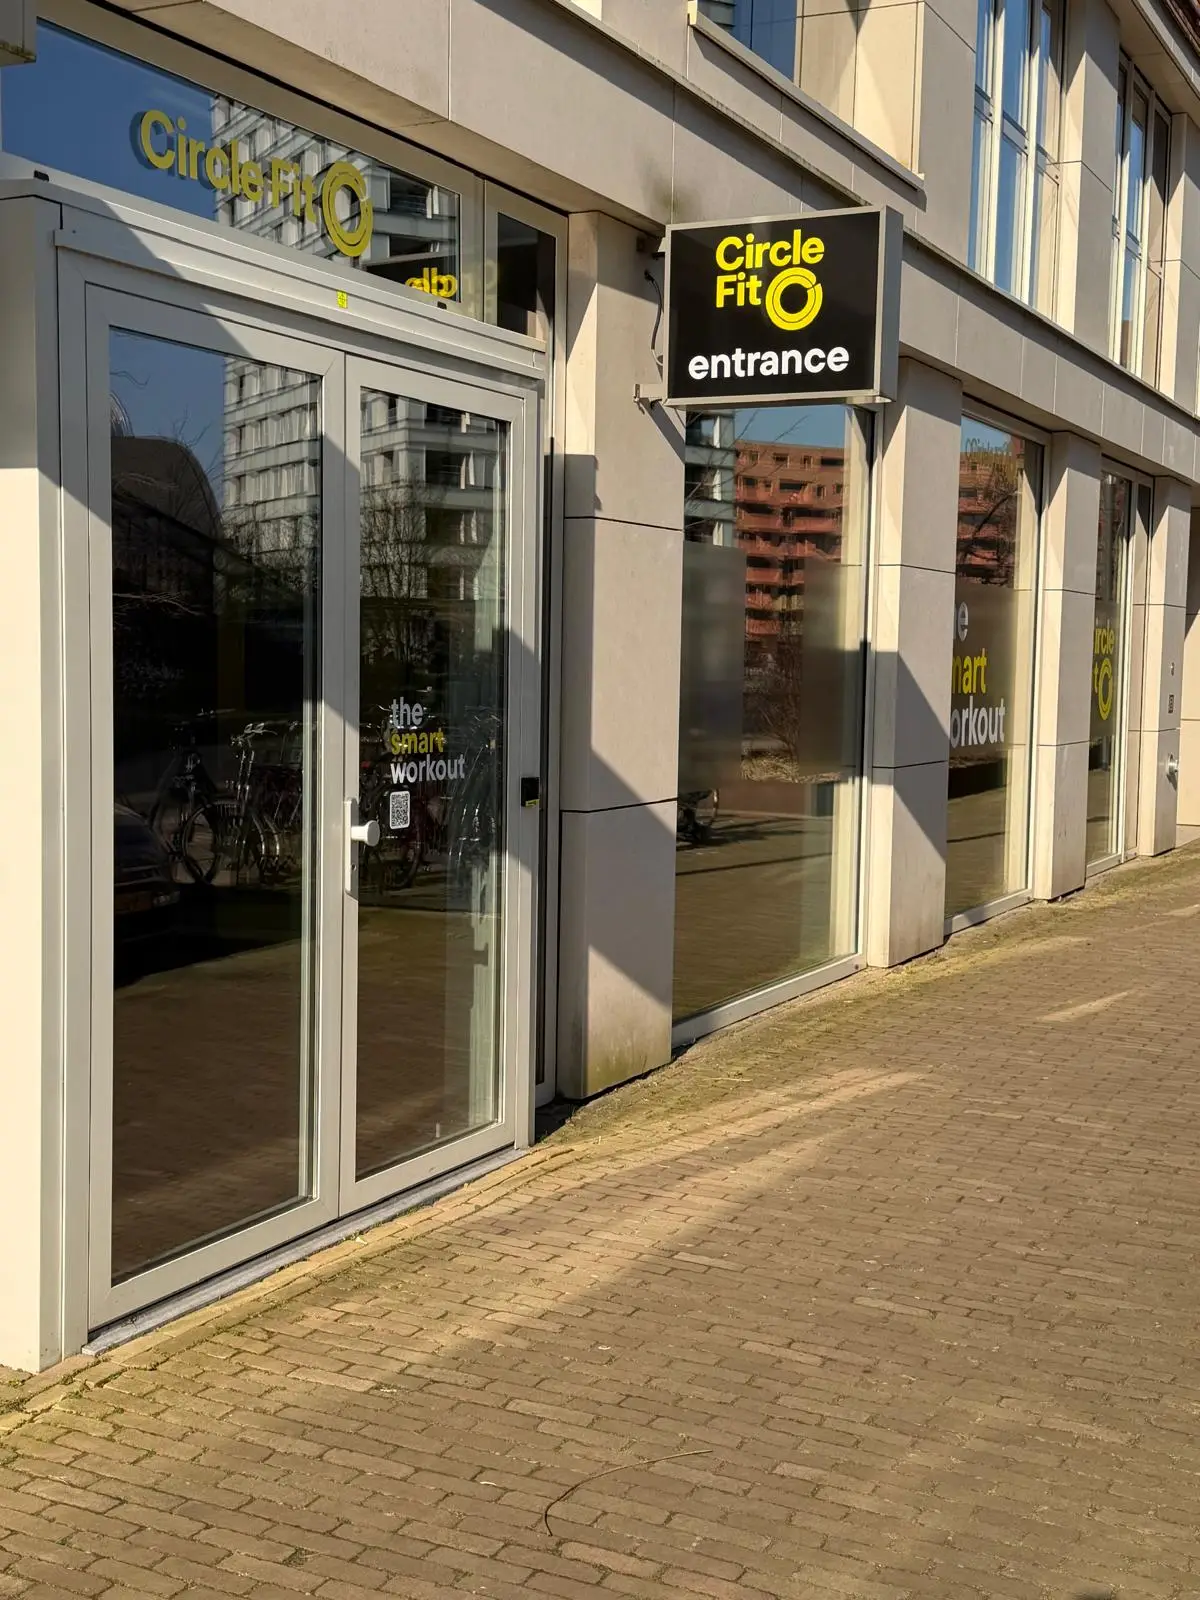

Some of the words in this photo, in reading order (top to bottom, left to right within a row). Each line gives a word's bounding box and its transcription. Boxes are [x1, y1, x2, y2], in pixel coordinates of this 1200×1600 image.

[141, 110, 264, 203] Circle
[271, 157, 317, 223] Fit
[715, 229, 825, 271] Circle
[716, 271, 762, 308] Fit
[688, 346, 850, 380] entrance
[390, 696, 424, 726] the
[950, 696, 1006, 749] orkout
[390, 728, 445, 755] smart
[390, 754, 465, 784] workout
